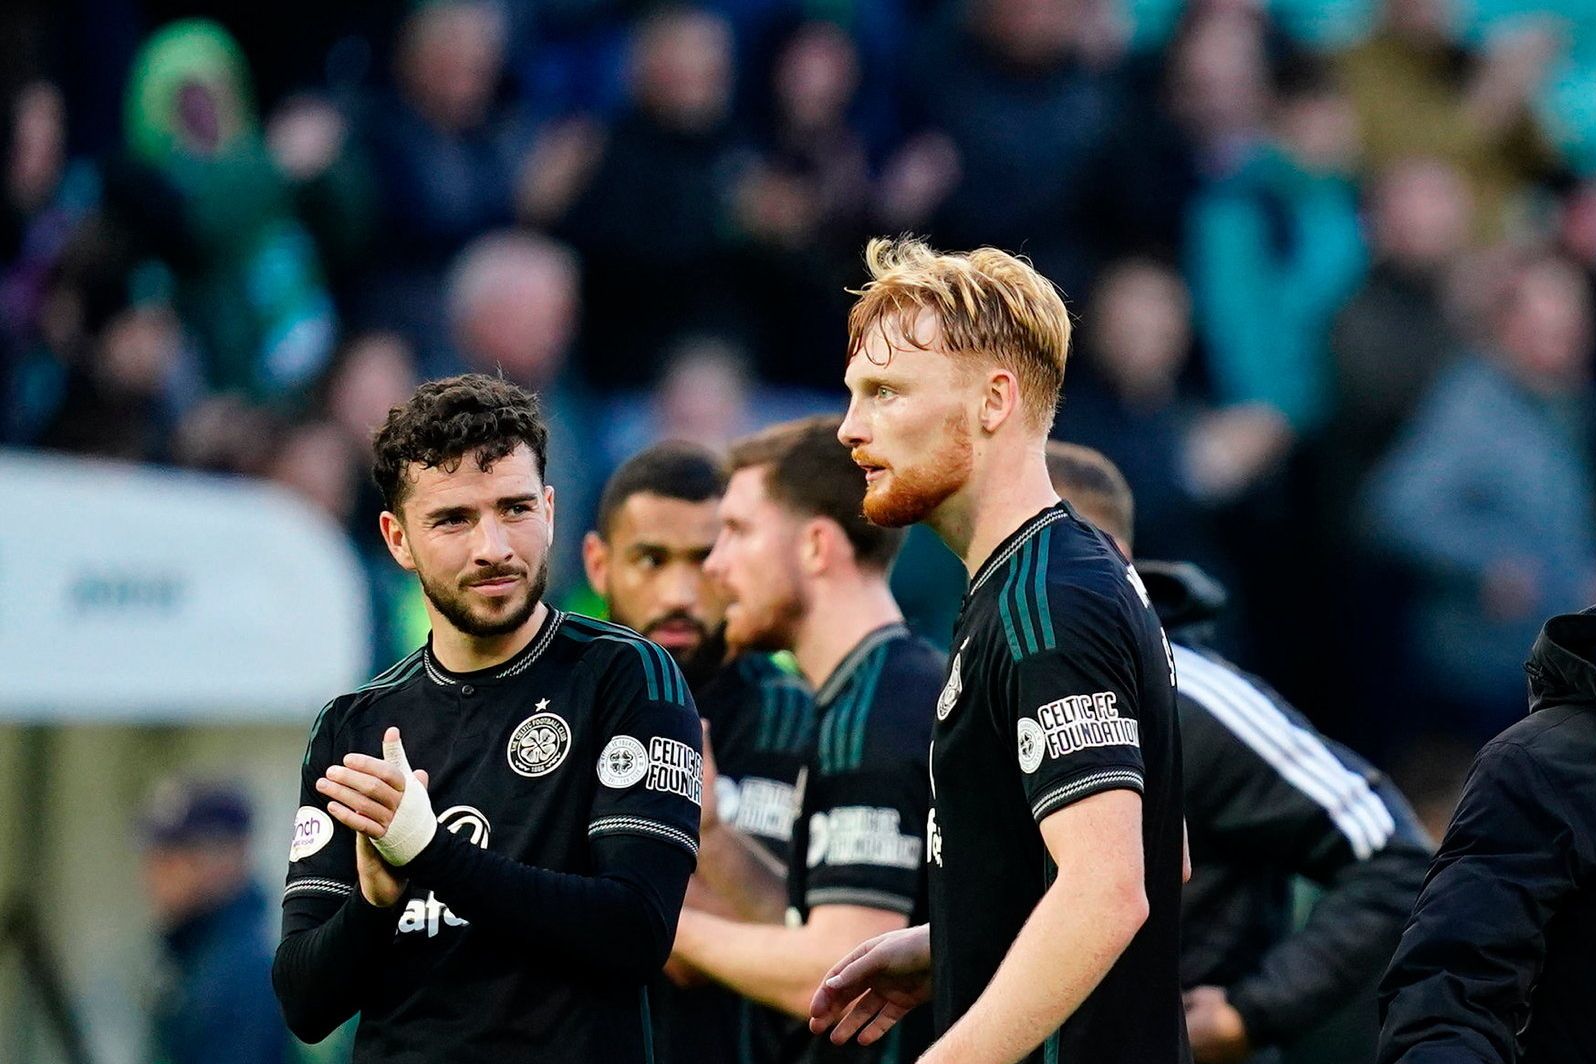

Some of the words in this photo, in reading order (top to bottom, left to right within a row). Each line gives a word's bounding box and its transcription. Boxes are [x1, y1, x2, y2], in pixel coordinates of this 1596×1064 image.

[1040, 697, 1093, 731] CELTIC
[1094, 693, 1117, 719] FC
[651, 738, 693, 773] CELTIC
